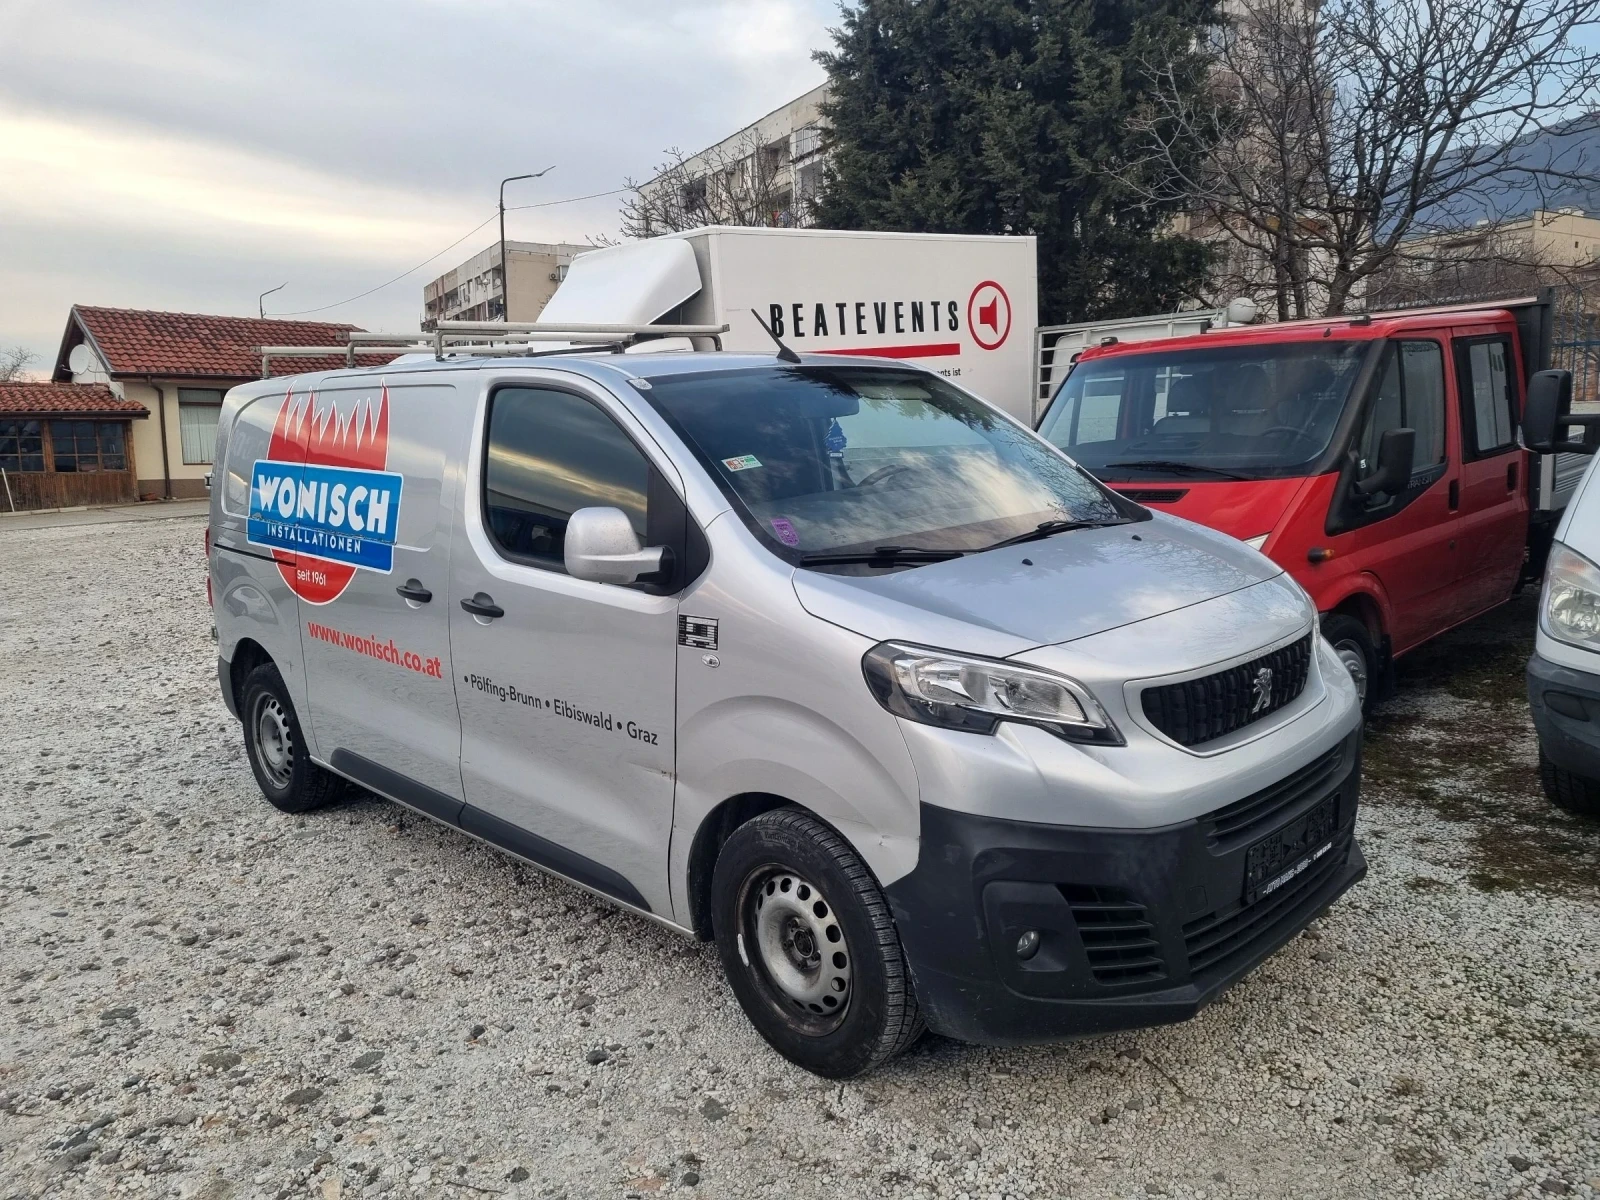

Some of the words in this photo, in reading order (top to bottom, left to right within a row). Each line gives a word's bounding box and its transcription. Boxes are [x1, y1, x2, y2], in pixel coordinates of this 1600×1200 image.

[769, 300, 959, 338] BEATEVENTS
[952, 367, 961, 376] ist
[258, 474, 390, 534] WONISCH
[267, 523, 361, 554] INSTALLATIONEN
[297, 569, 310, 582] seit
[312, 571, 326, 586] 1961
[308, 621, 442, 679] www.wonisch.co.at
[470, 674, 542, 709] Pölfing-Brunn
[553, 698, 613, 731] Eibiswald
[627, 721, 658, 746] Graz
